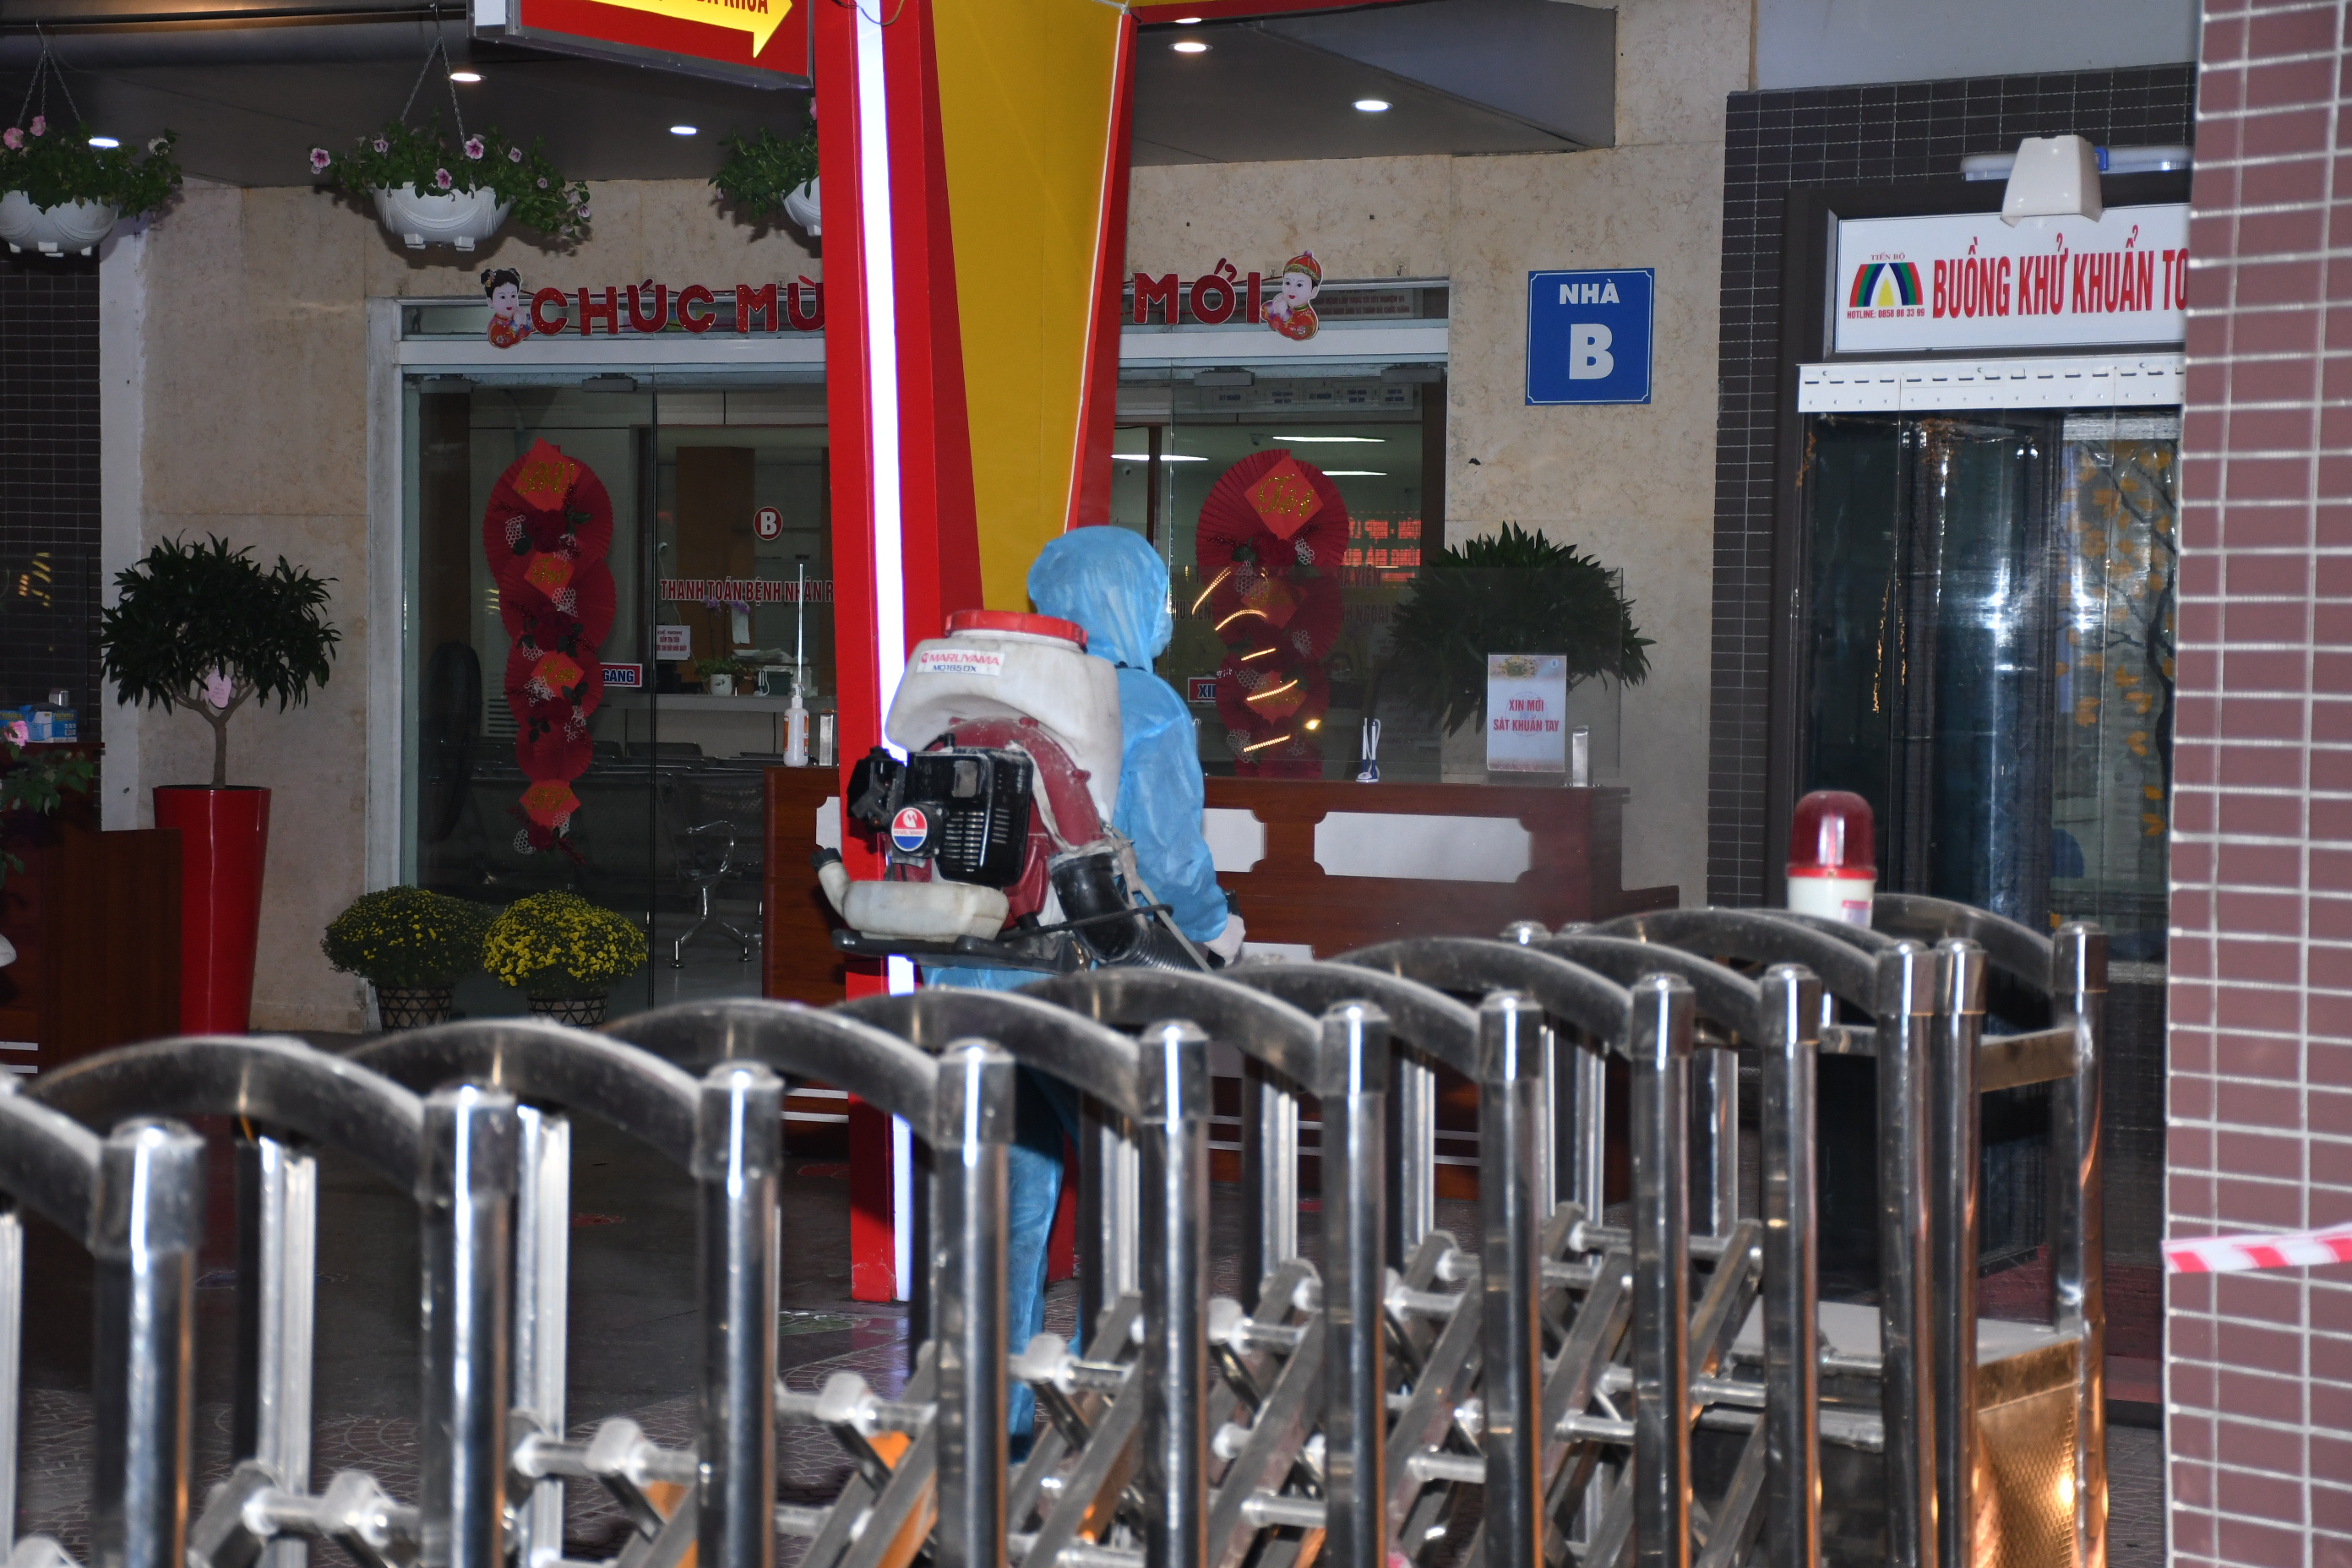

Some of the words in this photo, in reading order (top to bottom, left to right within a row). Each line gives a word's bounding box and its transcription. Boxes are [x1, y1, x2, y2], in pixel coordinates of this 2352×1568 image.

[1893, 252, 1906, 261] BỘ
[1933, 237, 2012, 318] BUỒNG
[2018, 232, 2069, 316] KHỬ
[2072, 225, 2155, 313] KHUẨN
[531, 279, 716, 336] CHÚC
[1133, 258, 1262, 325] MỚI
[1560, 278, 1620, 305] NHÀ
[1847, 309, 1876, 319] HOTLINE:
[1907, 308, 1915, 317] 33
[1917, 308, 1925, 317] 99
[1569, 323, 1614, 380] B
[760, 511, 777, 536] B
[660, 579, 705, 601] THANH
[706, 576, 743, 601] TOÁN
[745, 576, 782, 607] BỆNH
[929, 653, 1000, 666] MARUYAMA
[603, 668, 635, 684] GANG
[1509, 699, 1525, 711] XIN
[1527, 696, 1544, 712] MỜI
[1493, 716, 1511, 732] SÁT
[1512, 715, 1543, 732] KHUẨN
[1544, 719, 1560, 732] TAY
